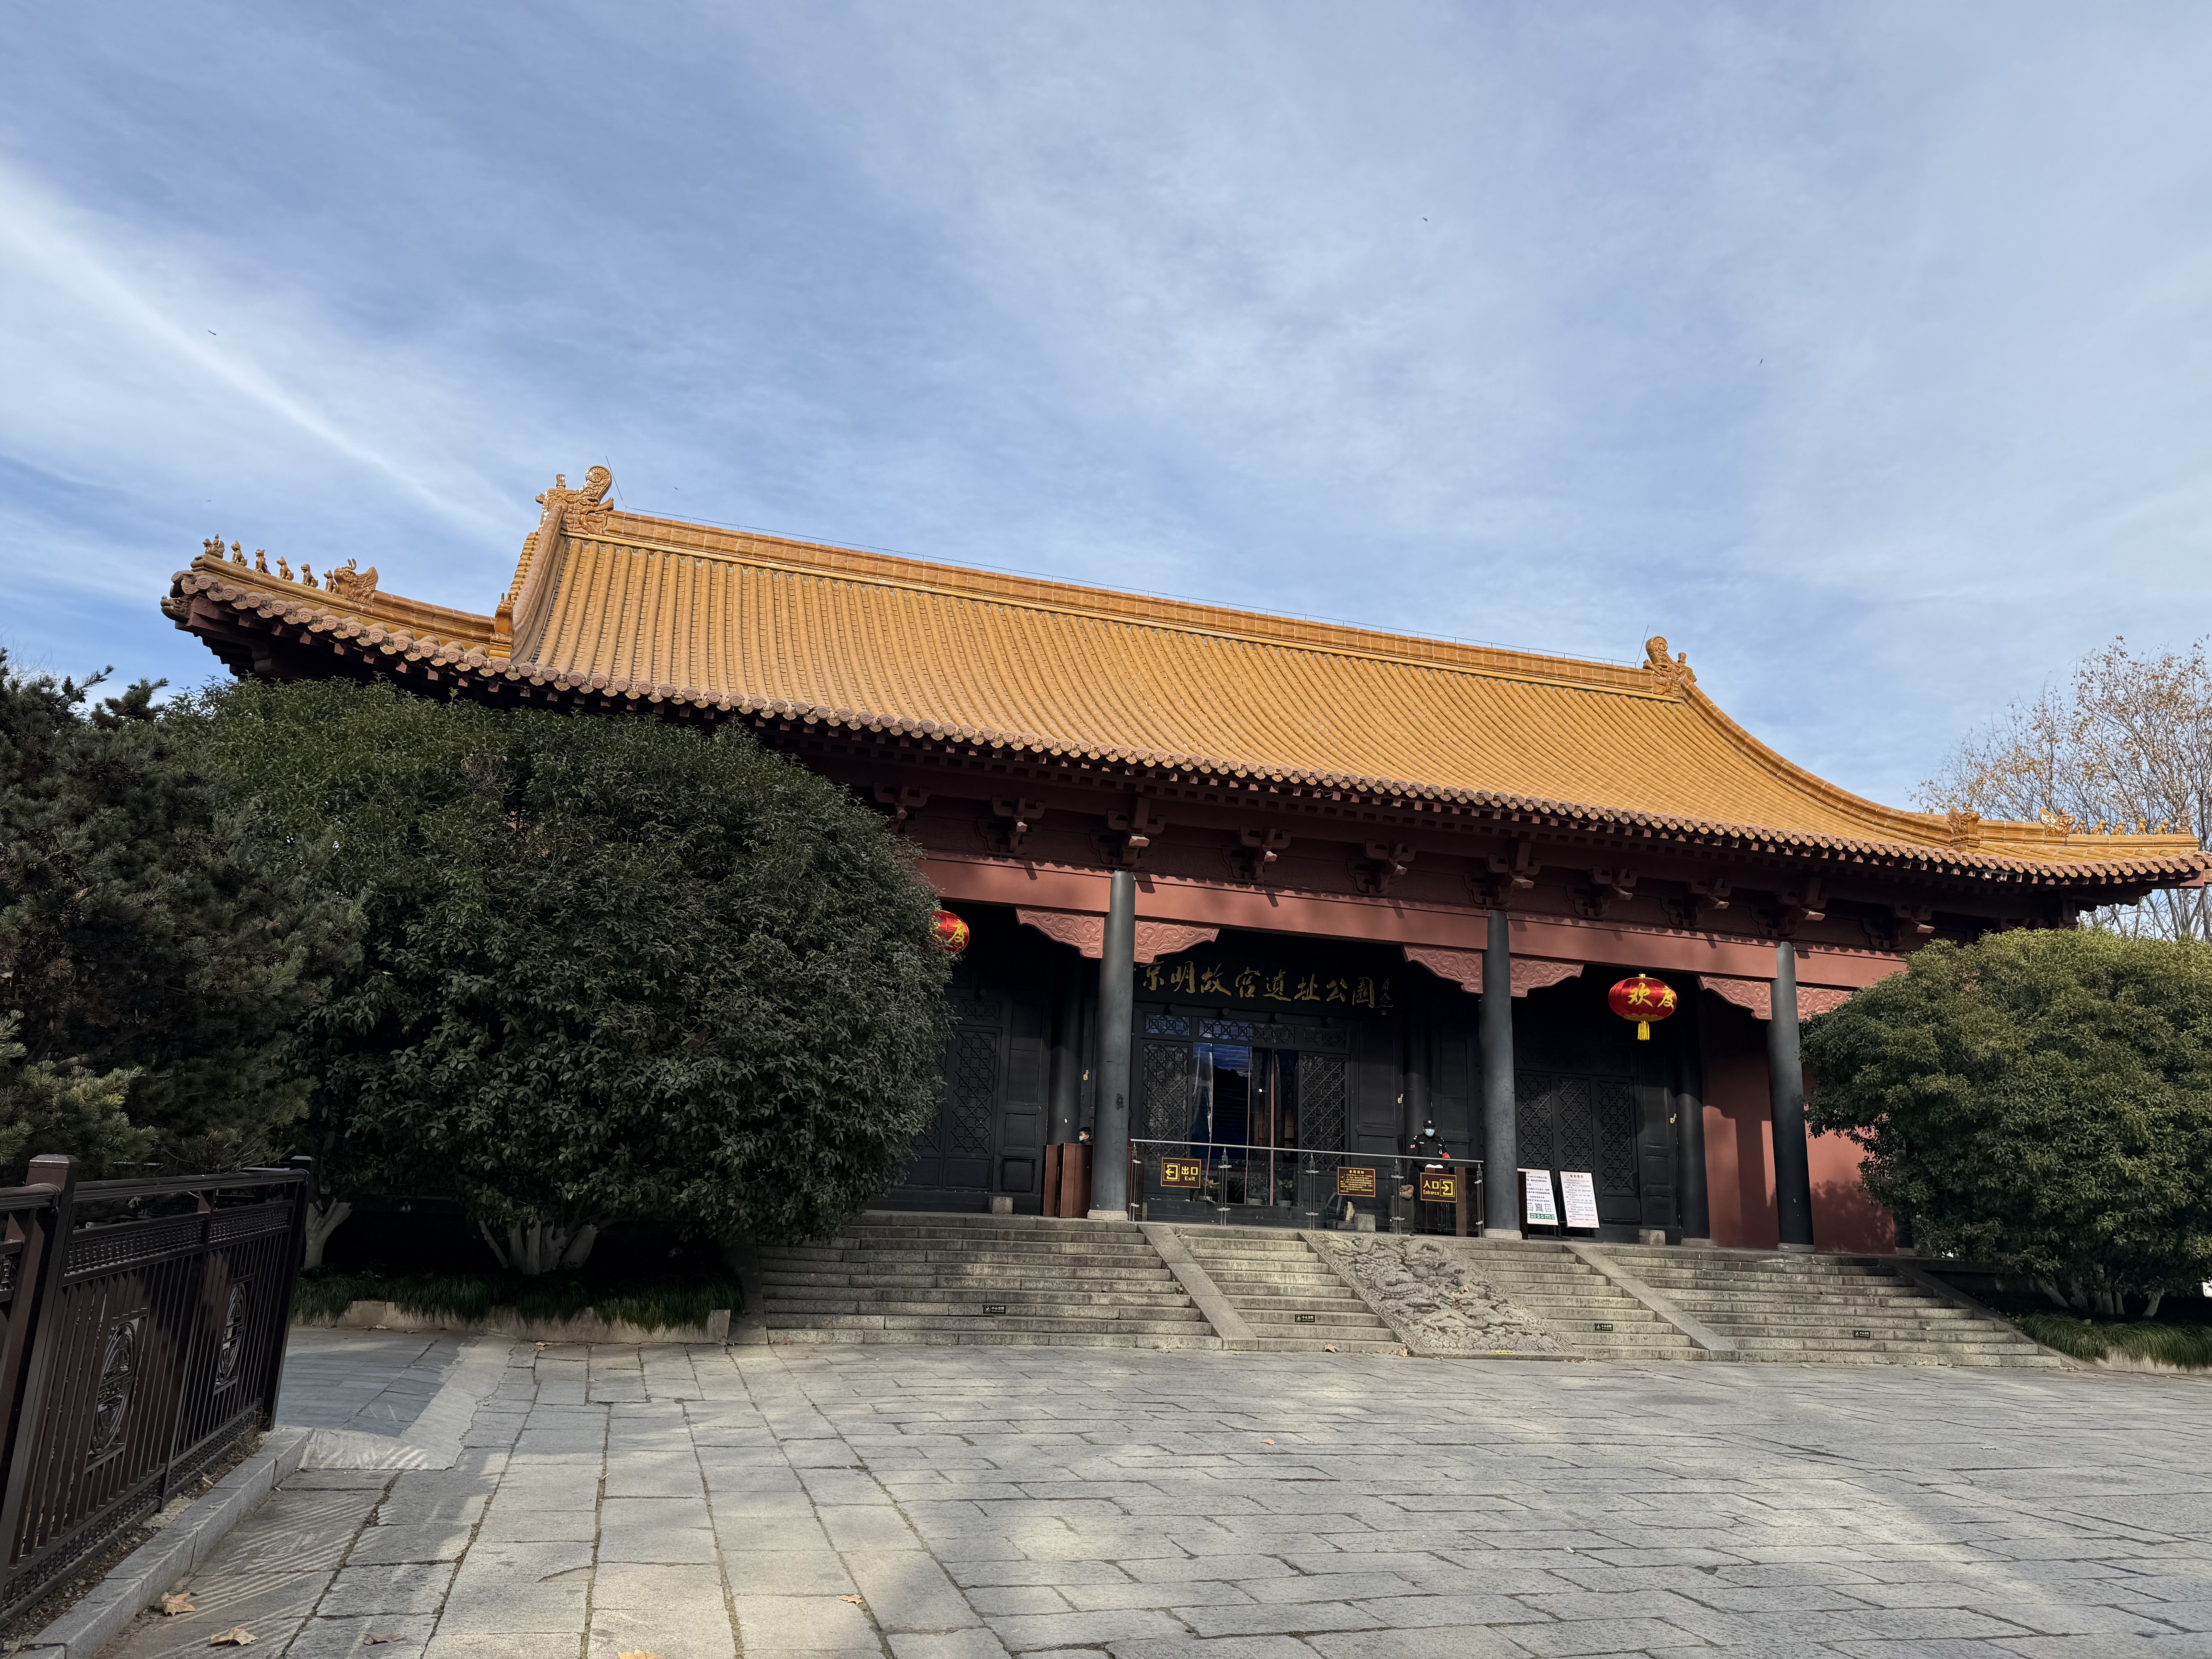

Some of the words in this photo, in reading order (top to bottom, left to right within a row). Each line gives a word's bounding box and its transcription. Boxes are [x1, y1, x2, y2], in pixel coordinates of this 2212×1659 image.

[1627, 982, 1674, 1010] 欢度
[1181, 1166, 1198, 1175] 出口
[1423, 1180, 1439, 1189] 入口
